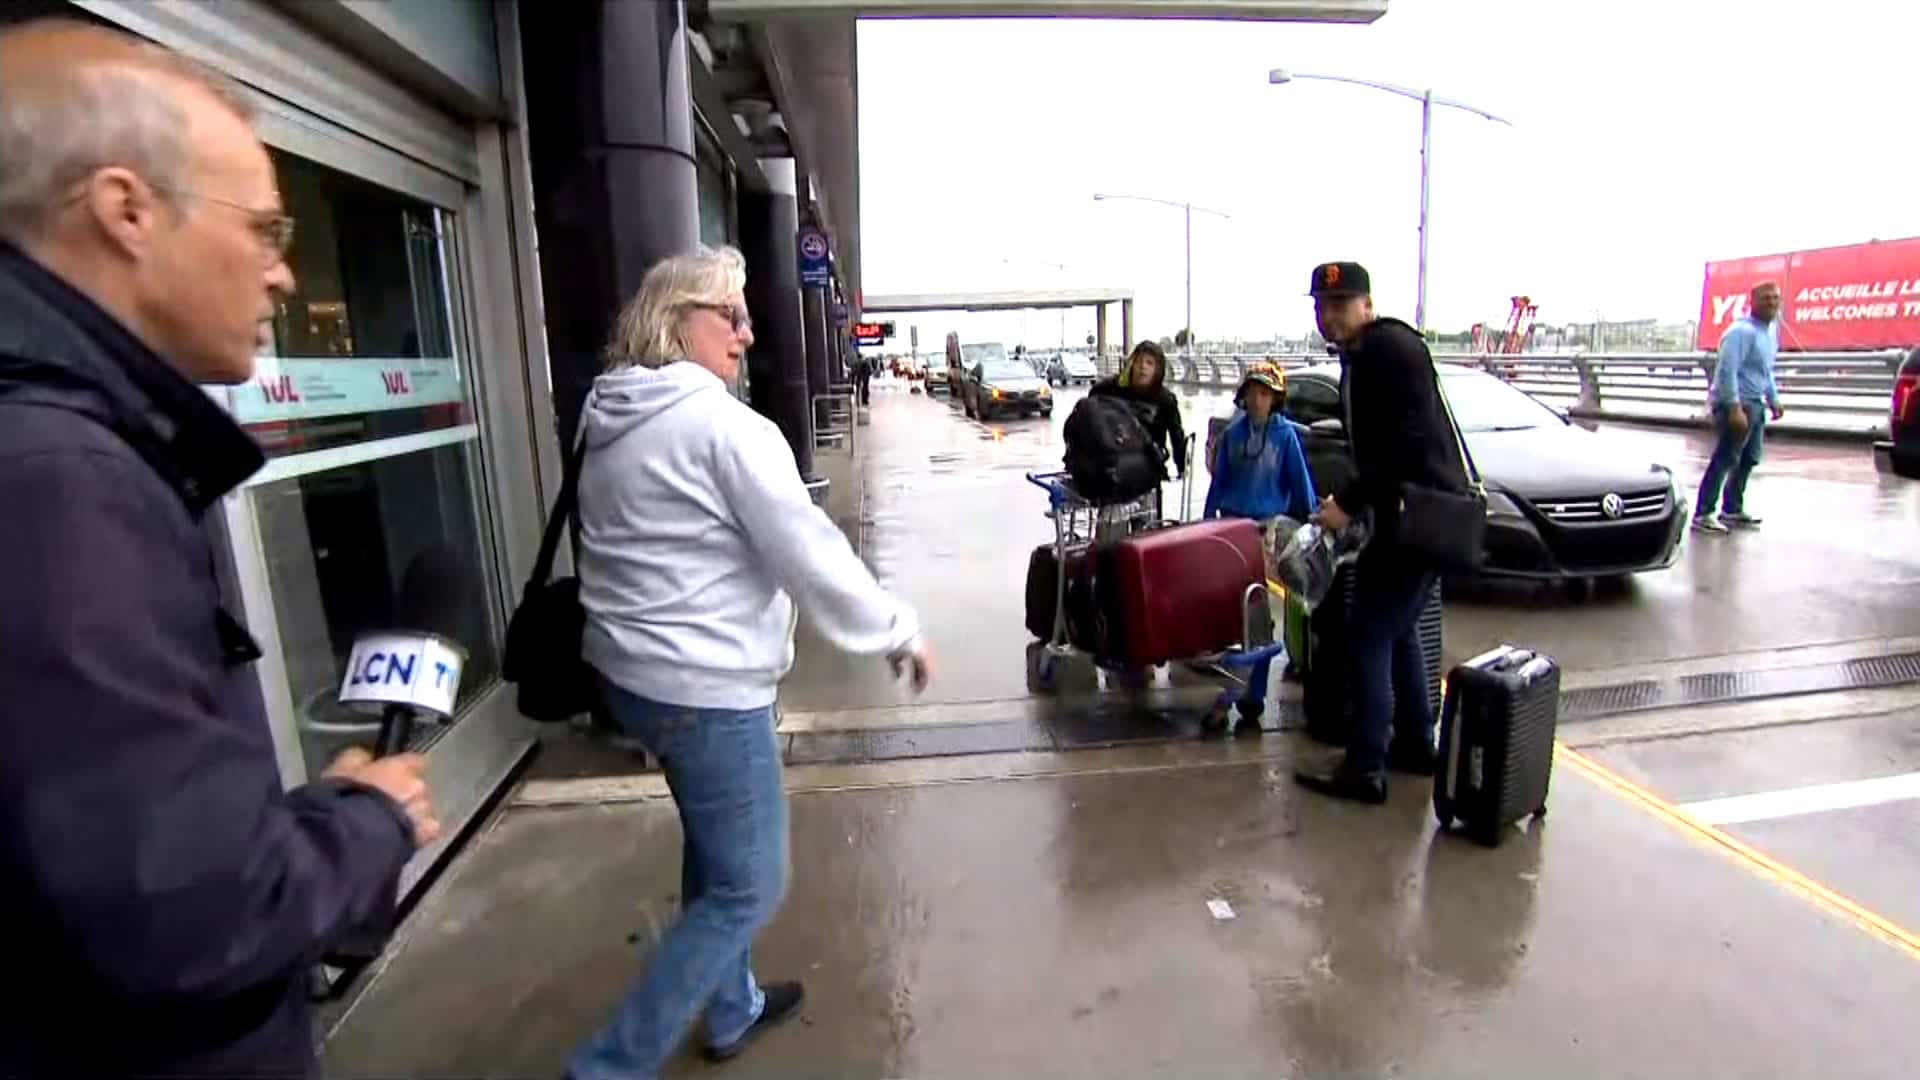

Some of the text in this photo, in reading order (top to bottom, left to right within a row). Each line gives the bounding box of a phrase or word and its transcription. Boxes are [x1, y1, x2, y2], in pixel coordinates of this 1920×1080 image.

[1795, 280, 1899, 302] ACCUEILLE
[1712, 295, 1752, 325] YU
[1795, 303, 1898, 322] WELCOMES
[350, 652, 416, 686] LCN
